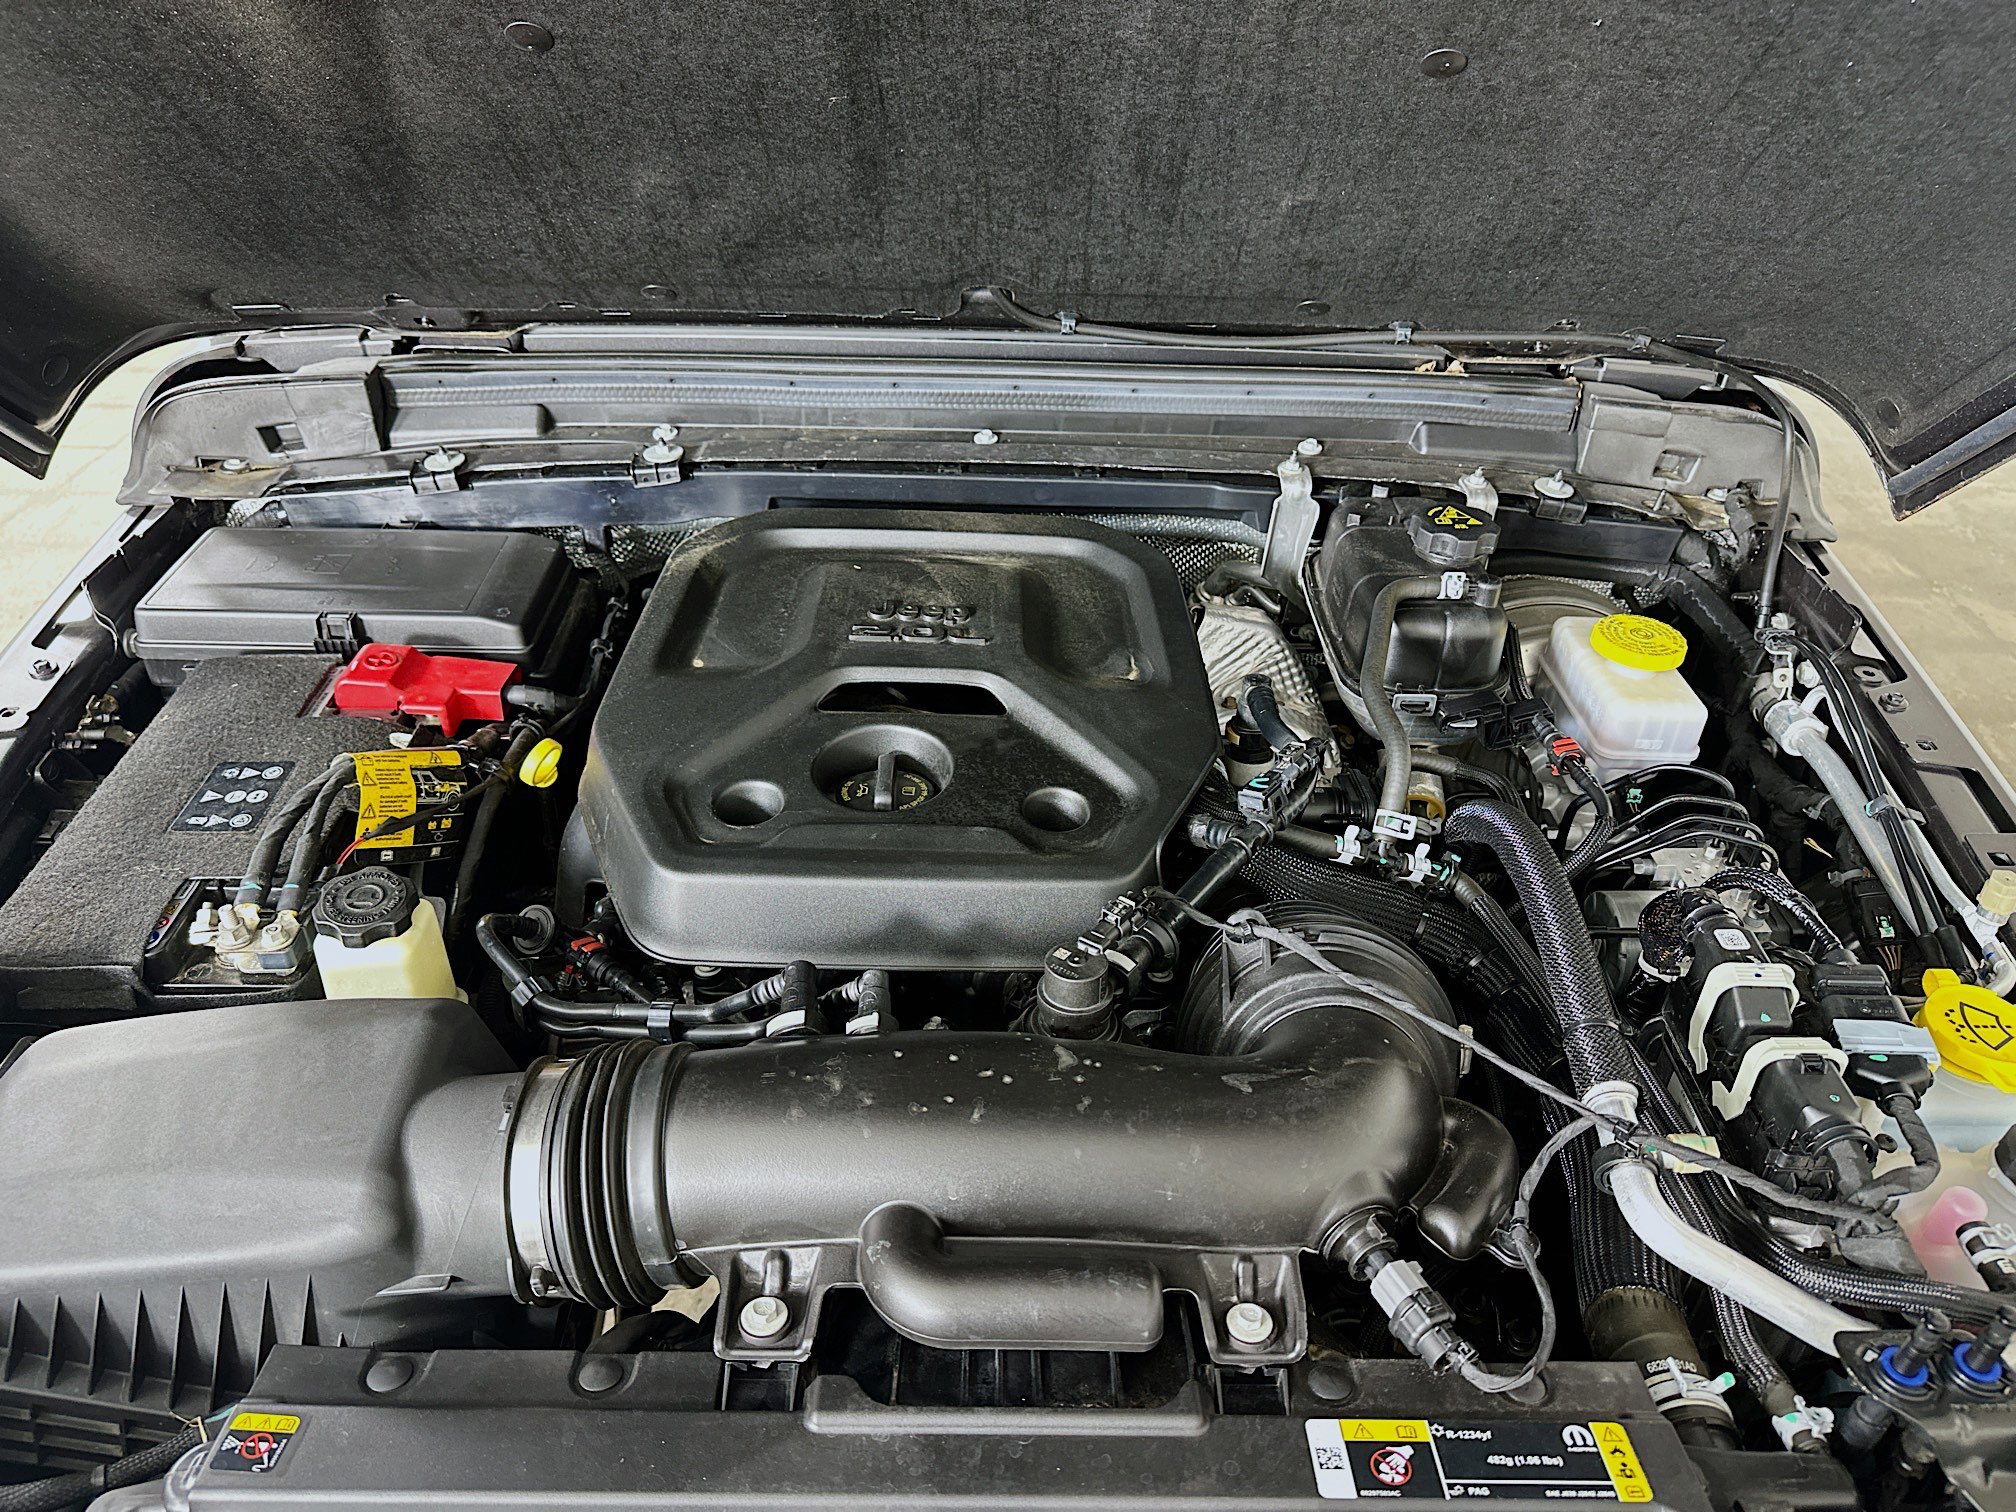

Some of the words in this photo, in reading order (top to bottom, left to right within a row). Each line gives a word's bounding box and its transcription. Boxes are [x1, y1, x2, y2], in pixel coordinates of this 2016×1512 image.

[866, 600, 974, 626] Jeep
[849, 624, 986, 646] 2.0L
[1467, 1486, 1490, 1496] PAG
